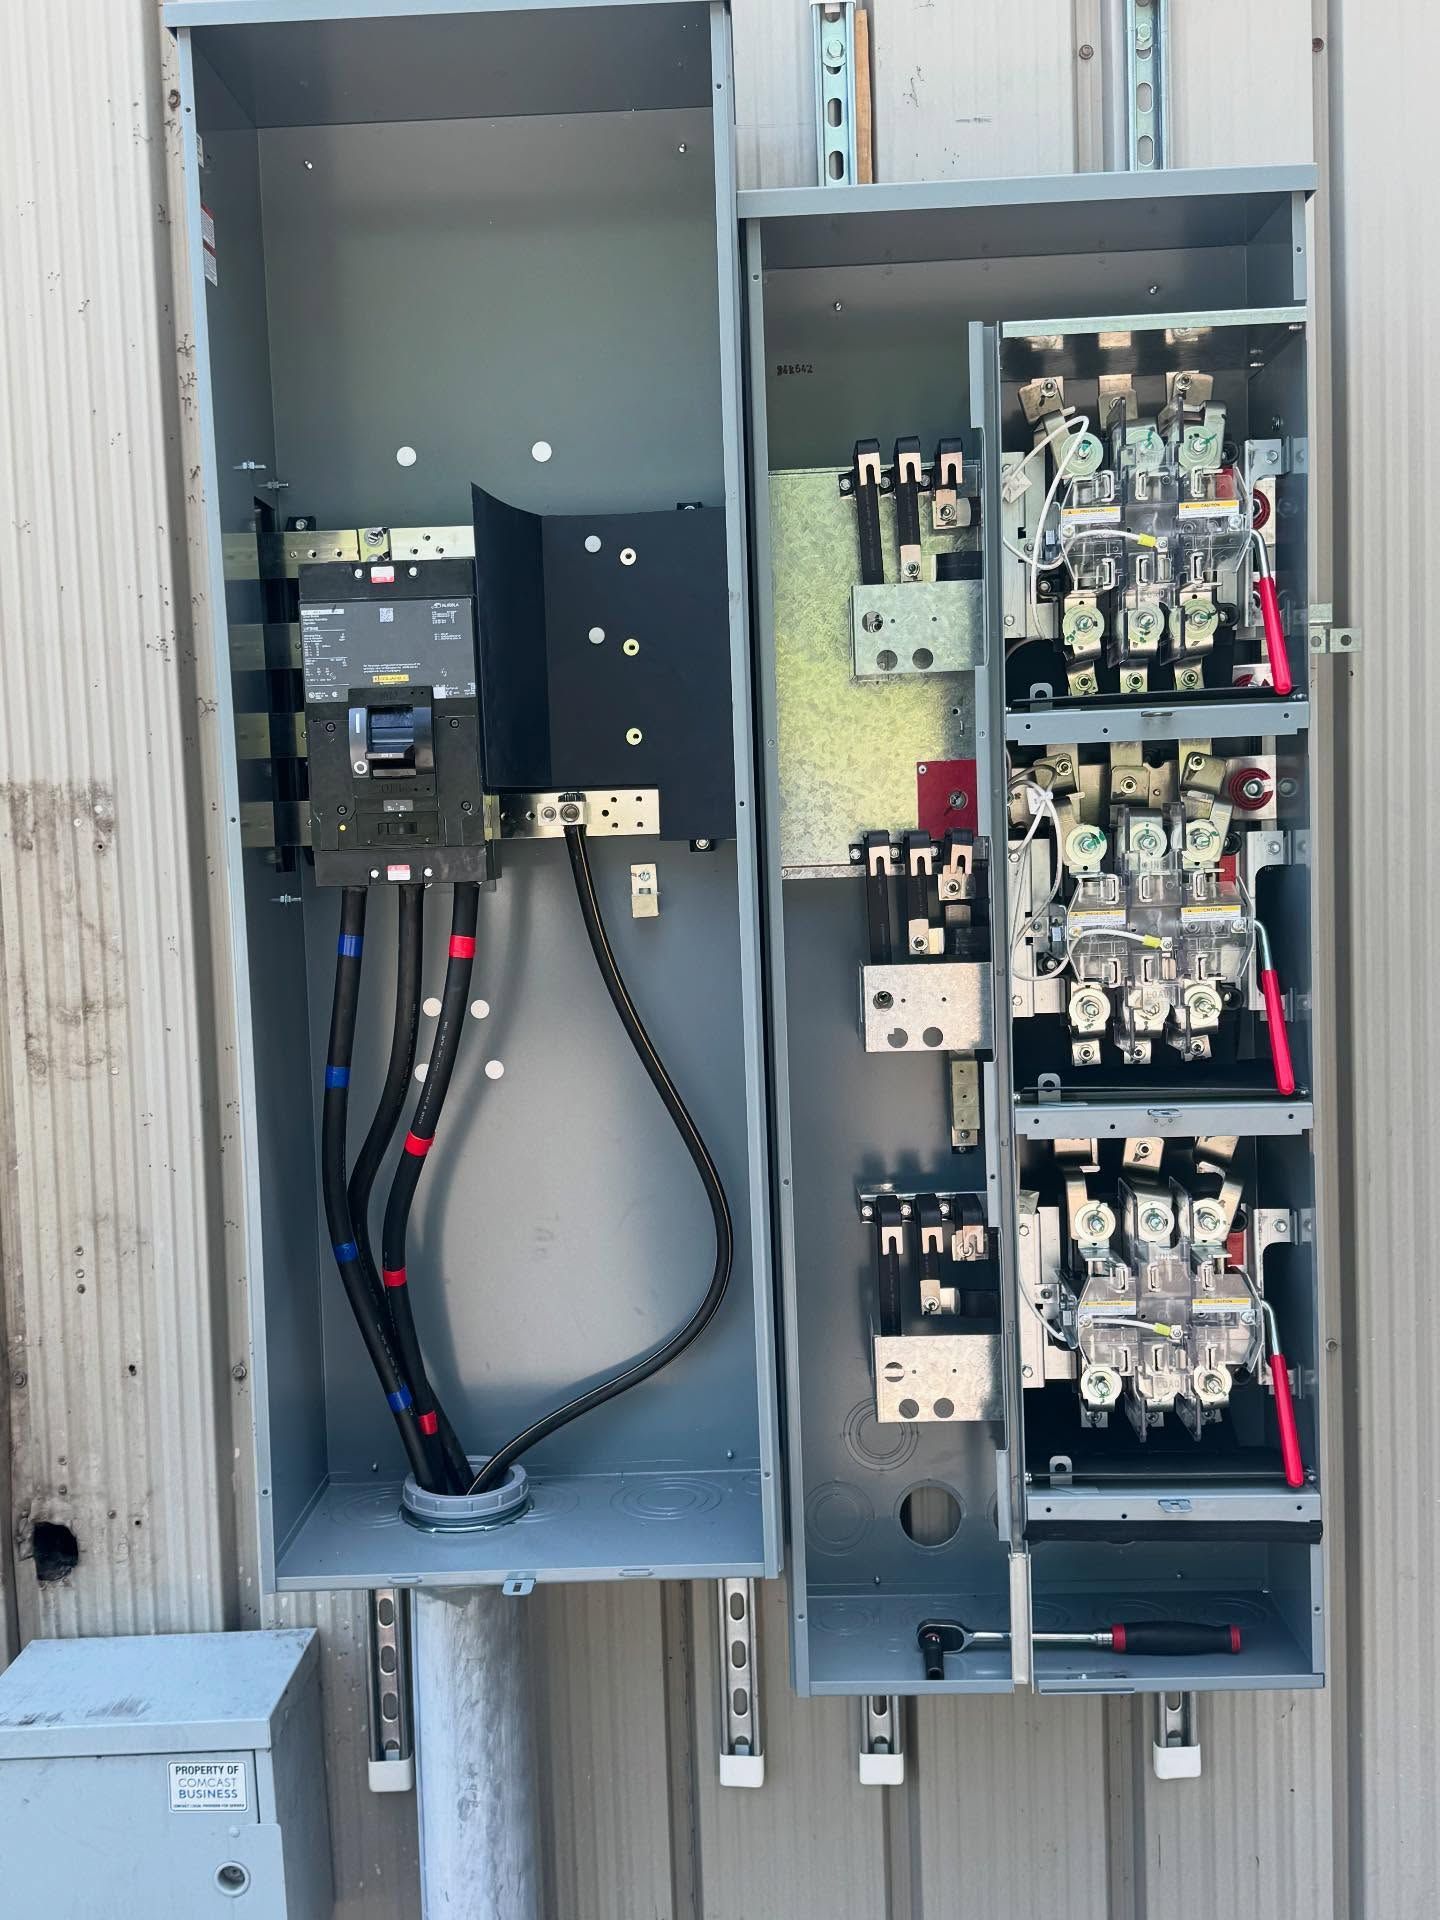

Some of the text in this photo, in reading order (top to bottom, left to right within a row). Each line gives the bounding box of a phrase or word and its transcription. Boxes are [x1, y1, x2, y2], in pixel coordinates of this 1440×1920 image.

[175, 1765, 239, 1775] PROPERTY OF
[178, 1777, 237, 1788] COMCAST
[178, 1789, 238, 1799] BUSINESS
